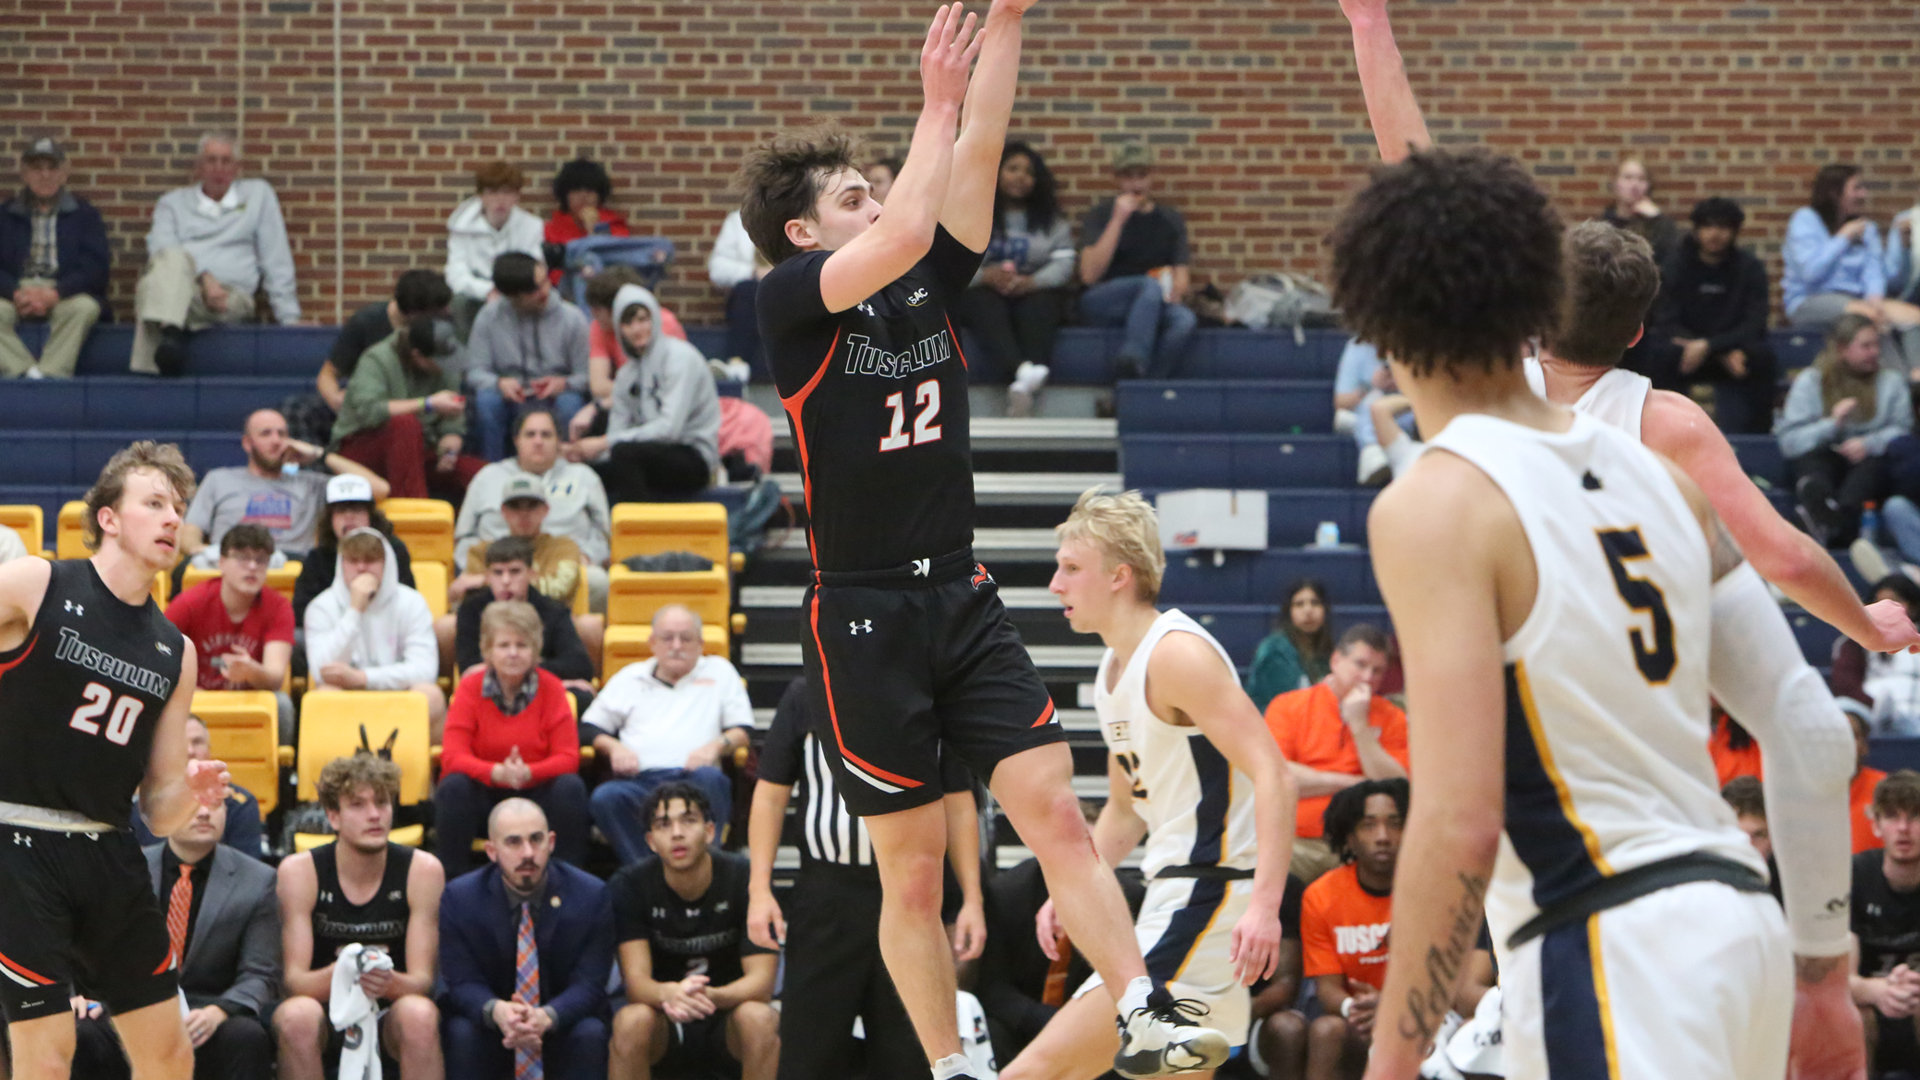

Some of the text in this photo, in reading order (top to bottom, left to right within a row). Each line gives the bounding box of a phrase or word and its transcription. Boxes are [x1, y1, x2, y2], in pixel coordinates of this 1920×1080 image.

[845, 329, 951, 379] TUSCLUM
[879, 378, 942, 452] 12
[1592, 523, 1680, 688] 5
[55, 625, 171, 701] TUSCULUM
[68, 681, 145, 746] 20
